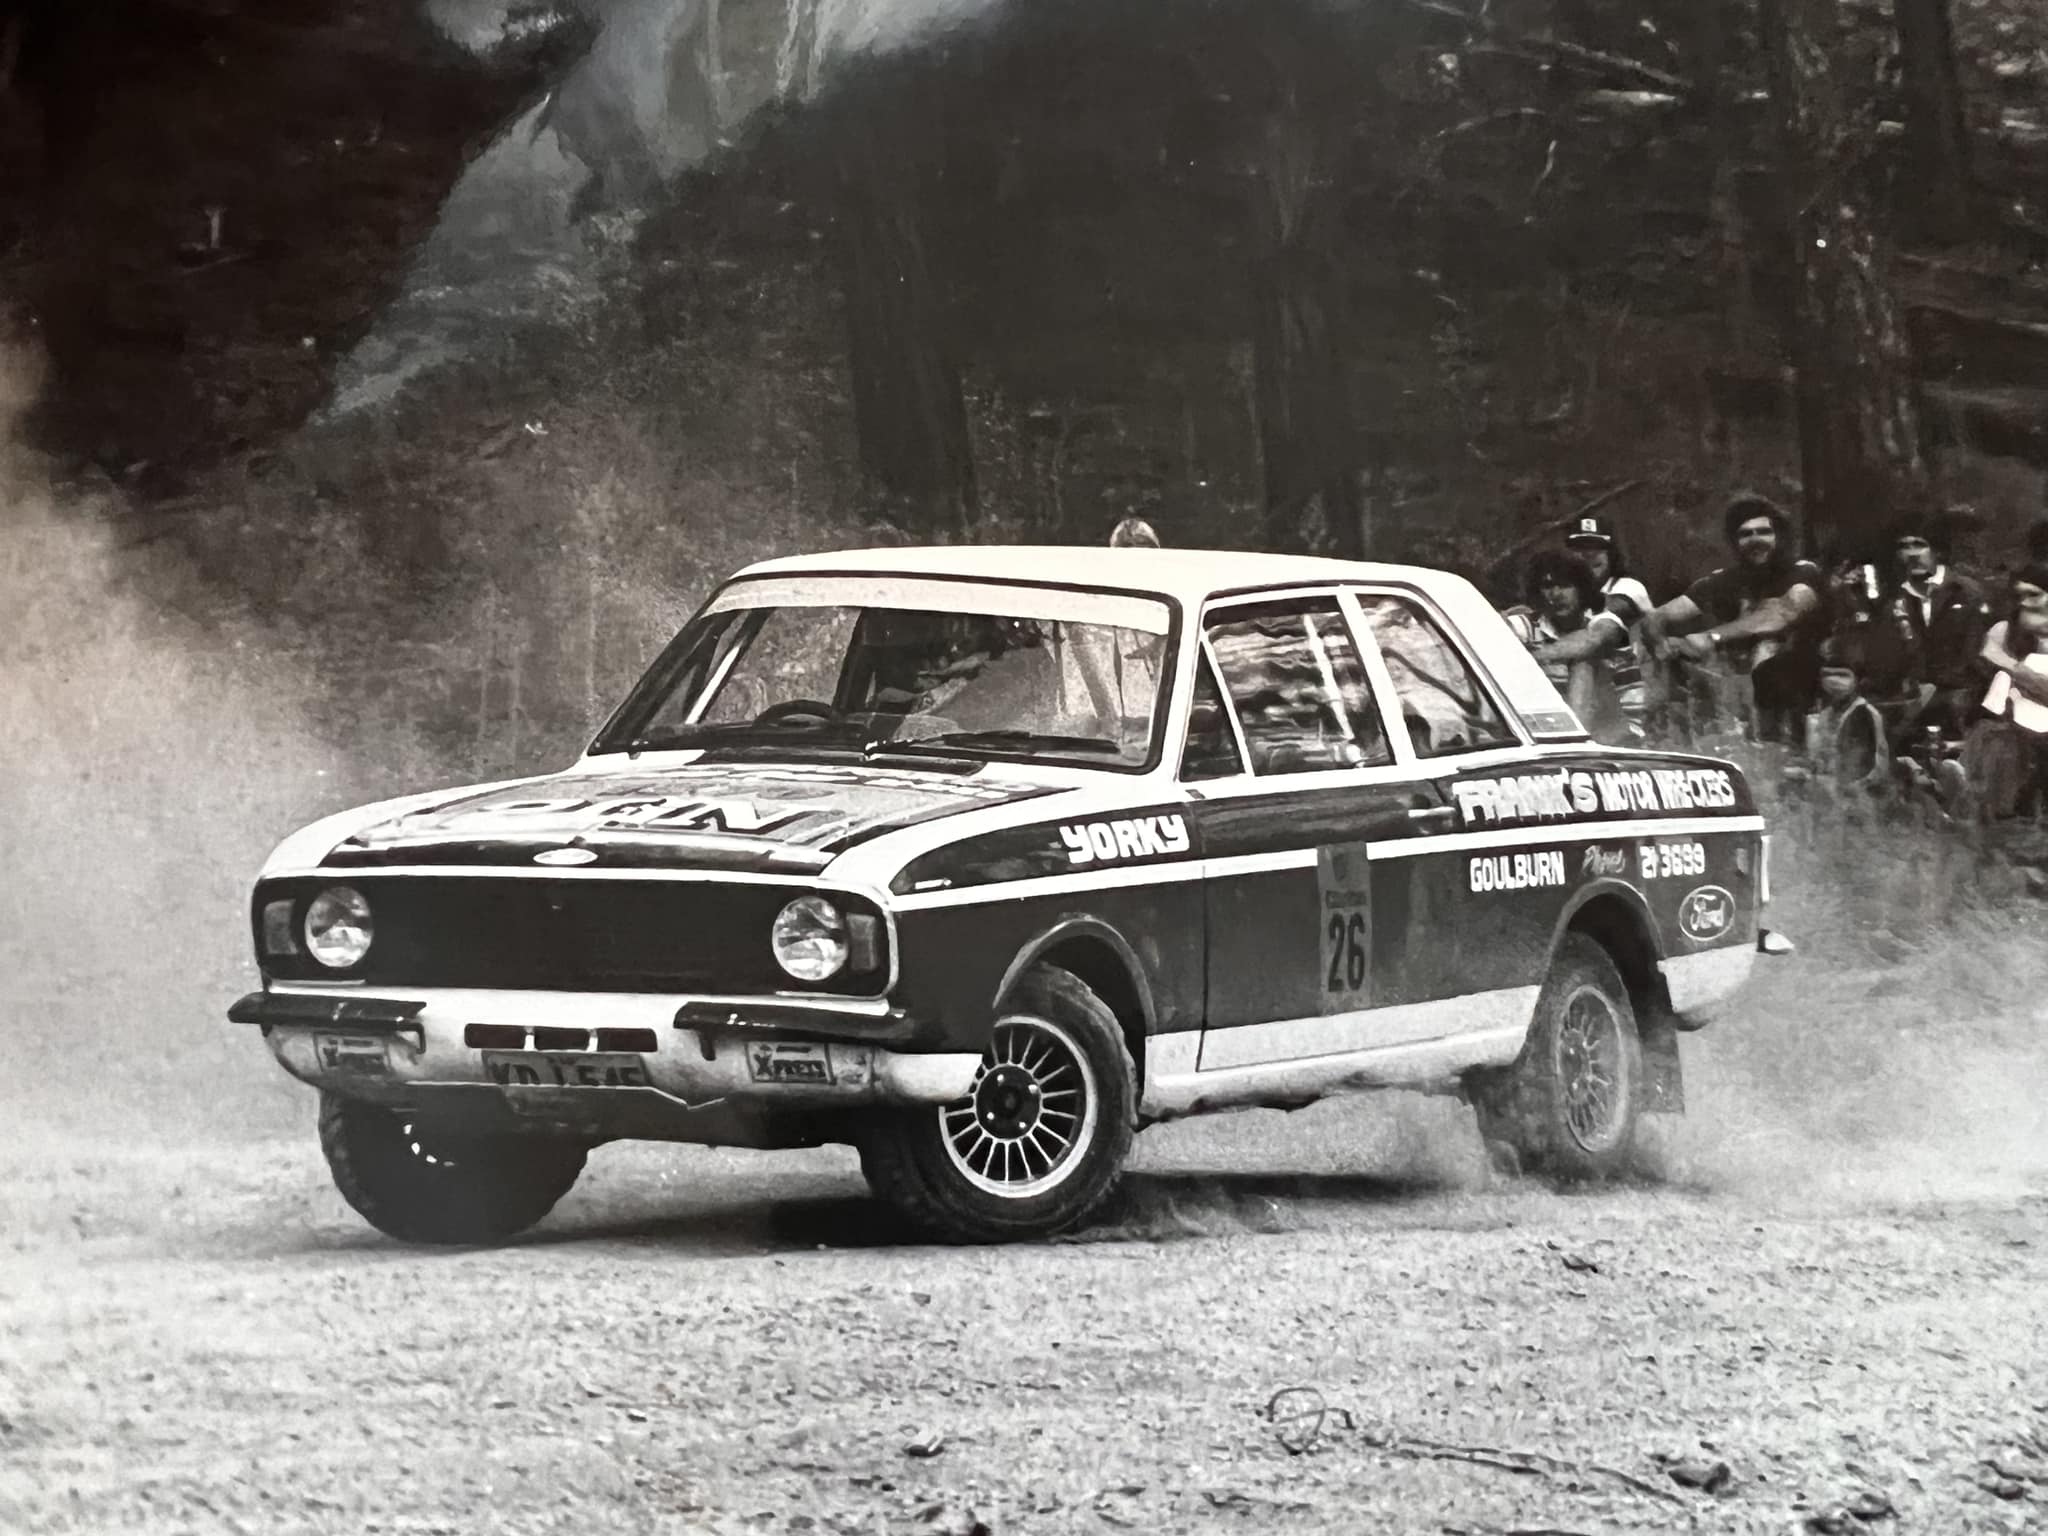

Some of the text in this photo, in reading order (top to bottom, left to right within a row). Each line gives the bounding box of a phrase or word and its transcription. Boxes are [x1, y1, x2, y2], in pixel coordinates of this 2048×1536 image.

[1594, 771, 1660, 812] MOTOR
[1059, 814, 1190, 864] YORKY
[1470, 851, 1565, 892] GOULBURN
[1328, 913, 1365, 992] 26
